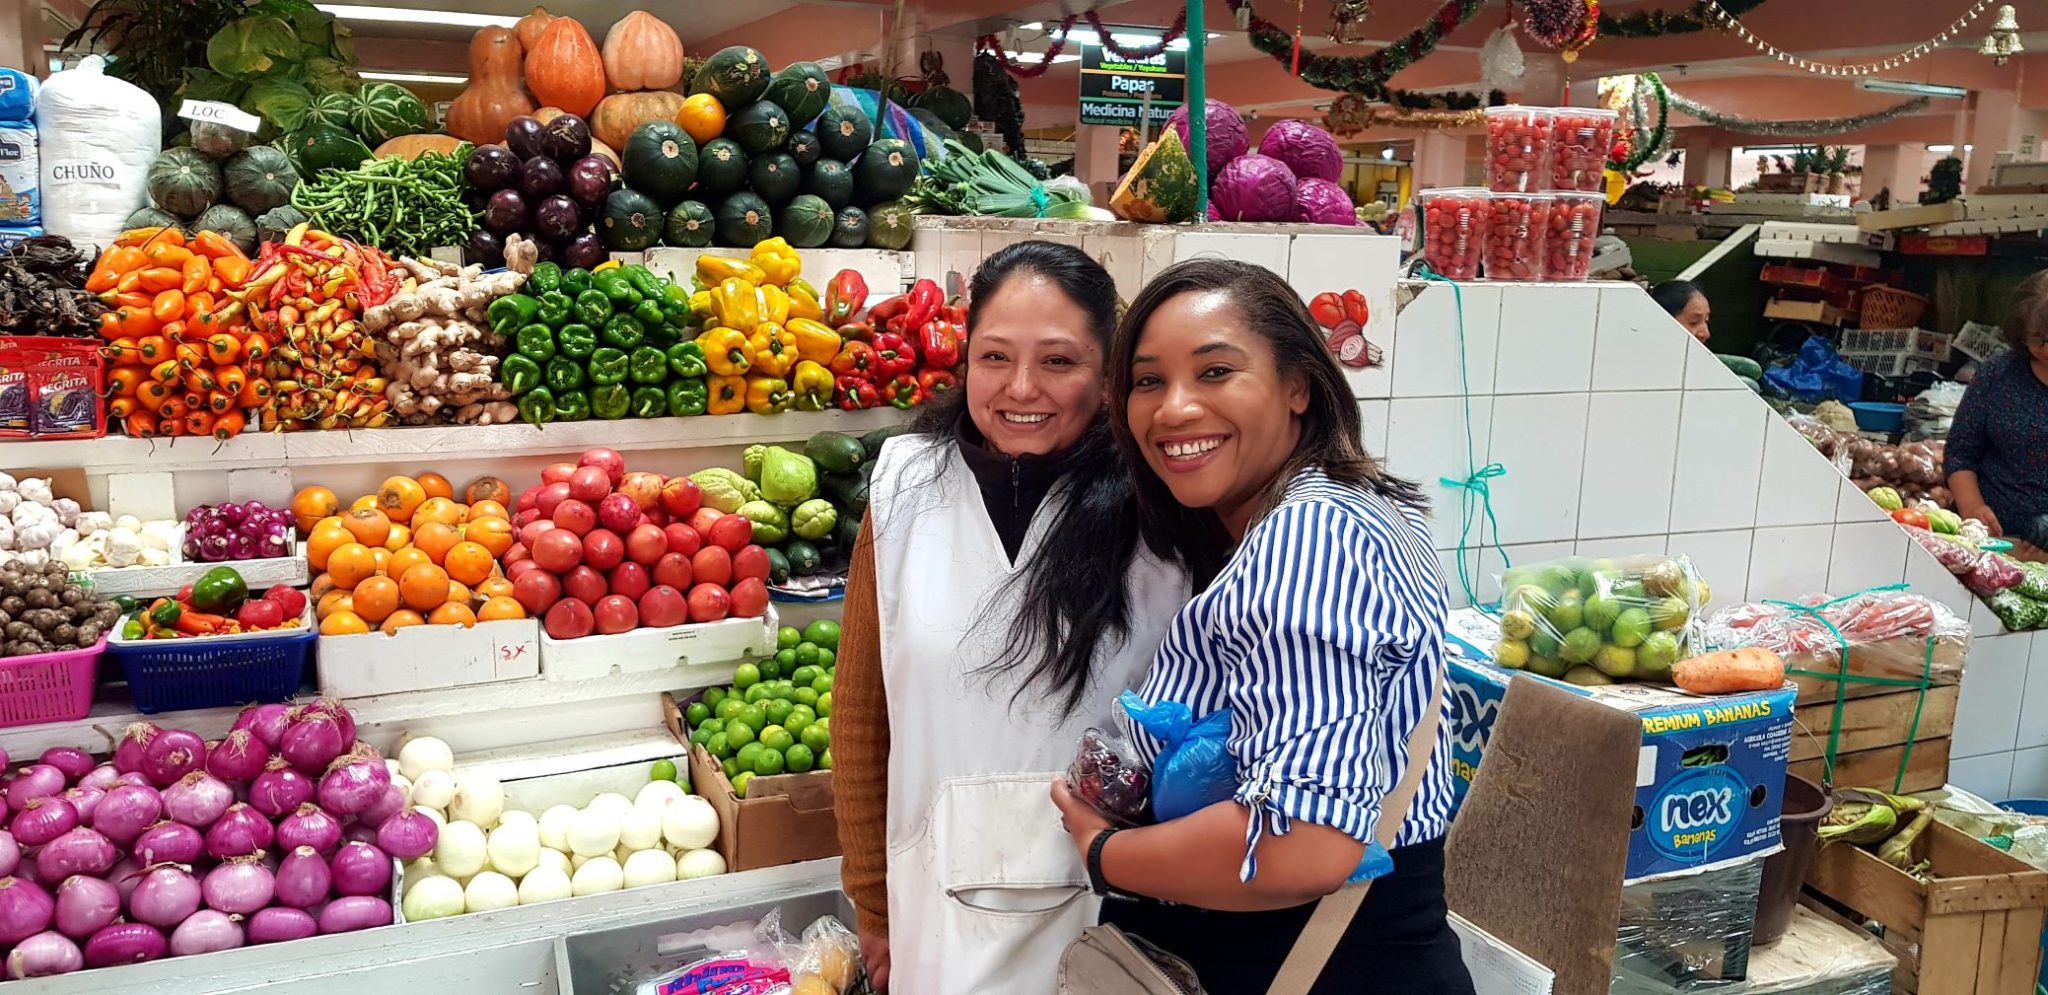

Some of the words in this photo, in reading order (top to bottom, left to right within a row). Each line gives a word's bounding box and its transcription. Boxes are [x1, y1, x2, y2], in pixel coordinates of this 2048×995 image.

[1111, 75, 1155, 93] Papas
[1082, 102, 1136, 117] Medicina
[52, 162, 115, 180] CHUÑO
[1703, 700, 1771, 726] BANANAS
[1661, 787, 1732, 832] nex
